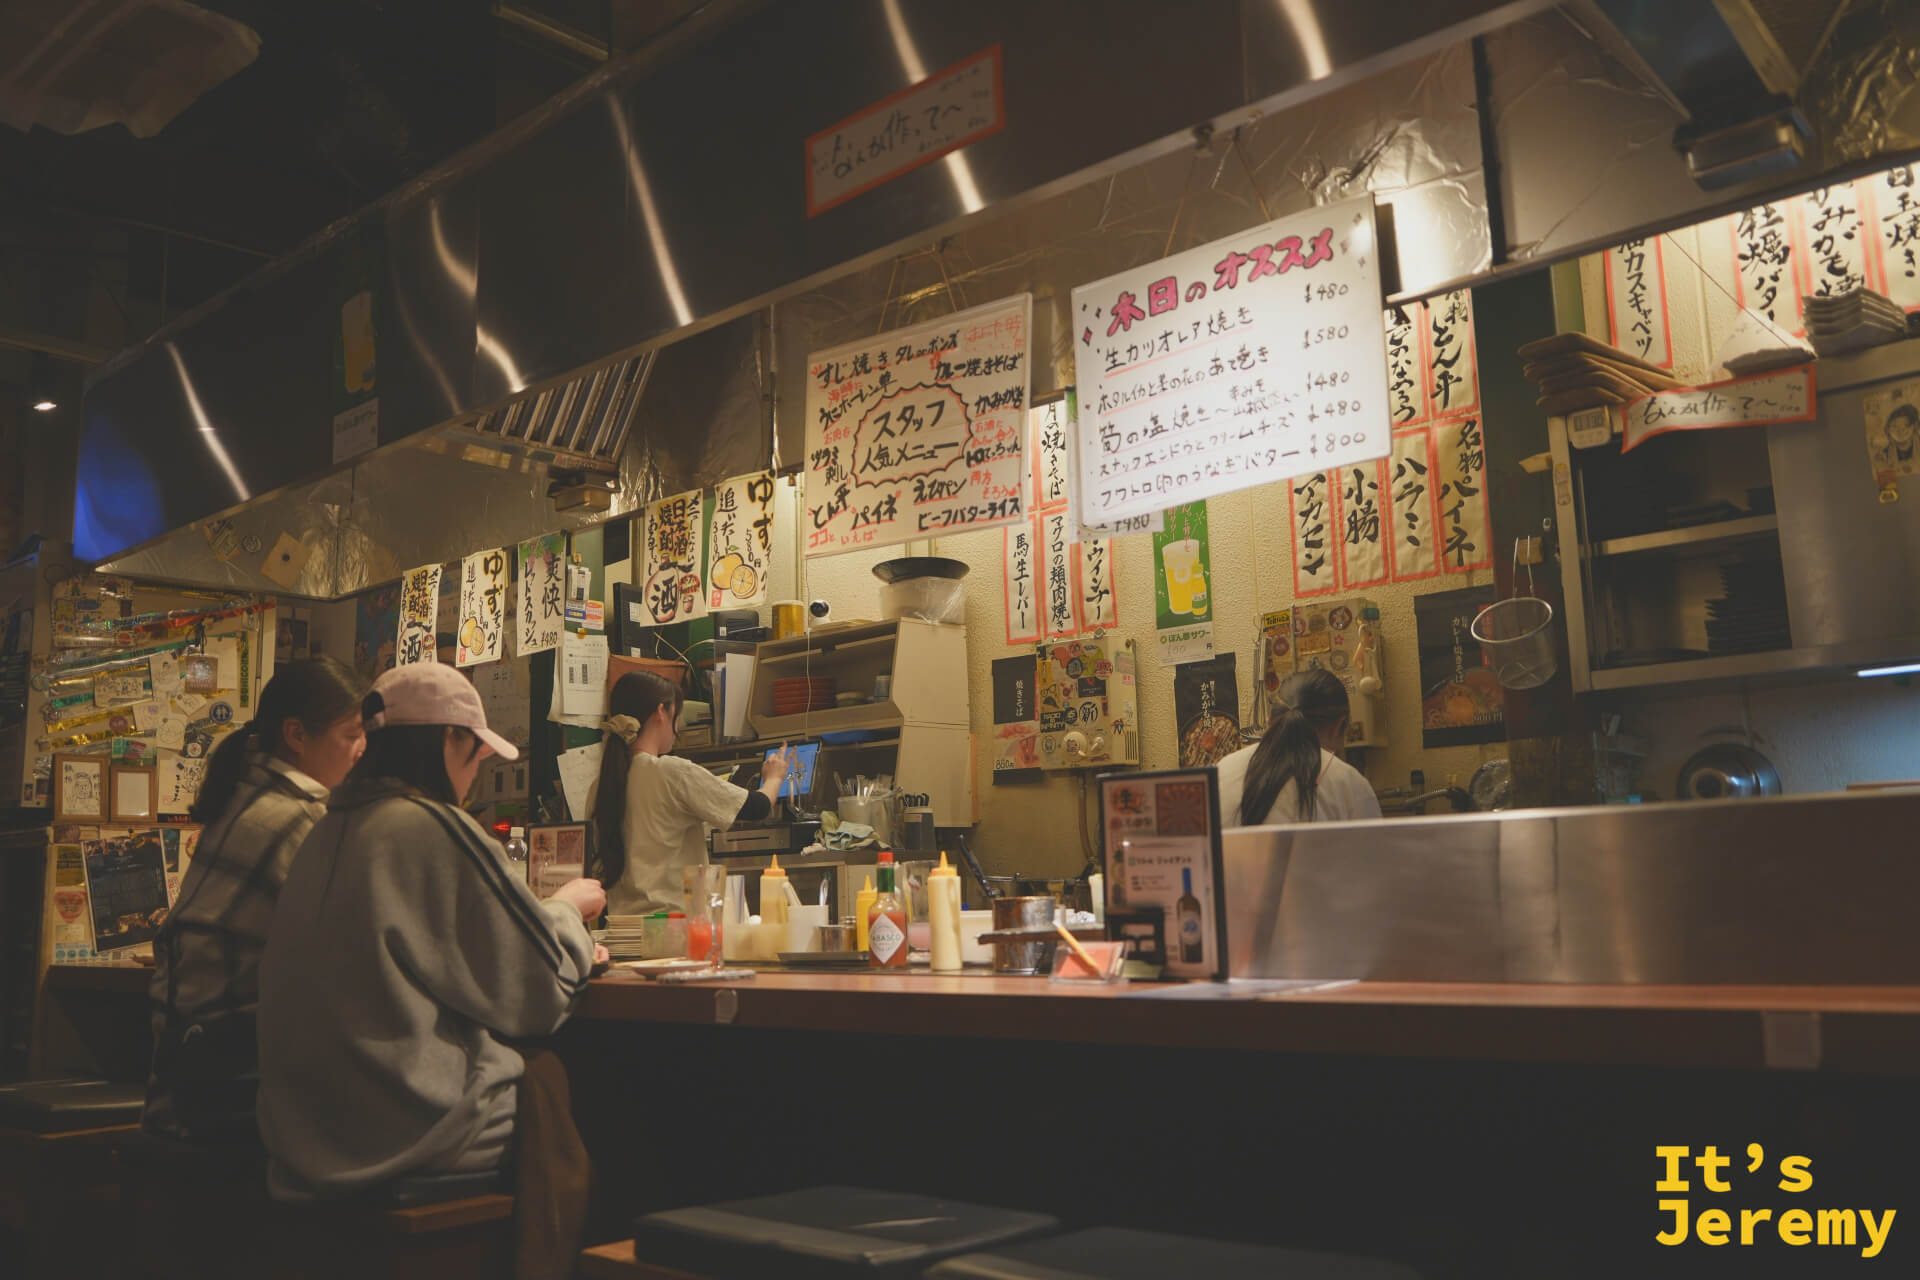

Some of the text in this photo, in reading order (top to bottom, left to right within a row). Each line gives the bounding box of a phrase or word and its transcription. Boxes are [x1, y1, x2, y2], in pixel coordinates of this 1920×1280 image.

[1106, 227, 1334, 337] 本日のオススメ
[872, 400, 946, 443] スタッフ
[860, 442, 960, 474] 人気メニュー
[673, 498, 688, 557] 日本酒
[1345, 468, 1379, 545] 小腸
[1392, 458, 1427, 546] ハラミ
[1440, 476, 1479, 567] パイネ
[484, 551, 504, 614] ゆず
[542, 554, 563, 619] 爽快
[650, 576, 678, 615] 酒
[401, 633, 421, 665] 酒
[1015, 679, 1024, 717] 焼きそば
